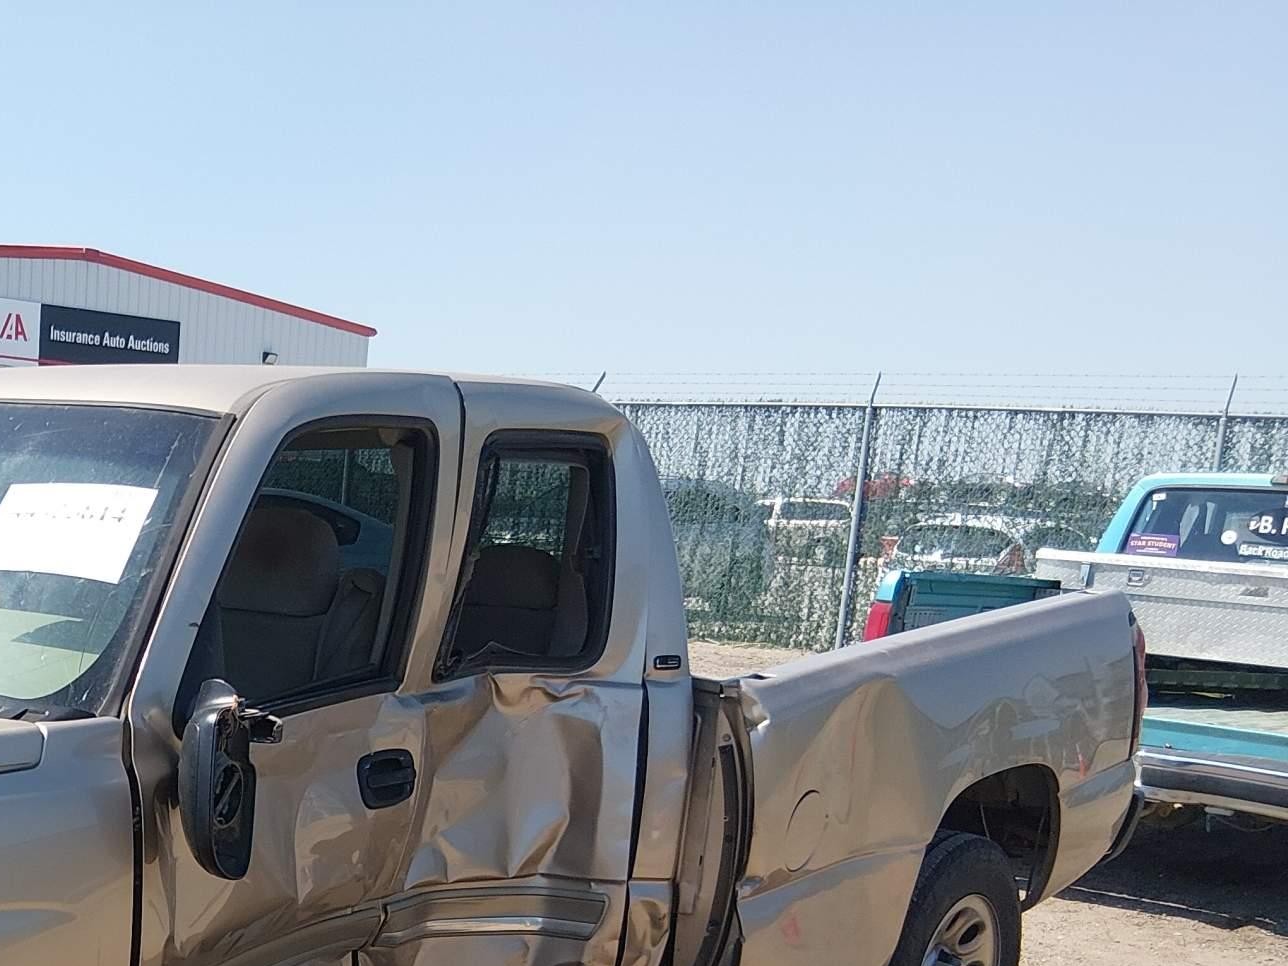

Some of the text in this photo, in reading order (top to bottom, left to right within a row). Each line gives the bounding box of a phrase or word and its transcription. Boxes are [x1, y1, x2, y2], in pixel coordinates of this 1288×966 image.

[50, 324, 170, 354] Insurance Auto Auctions
